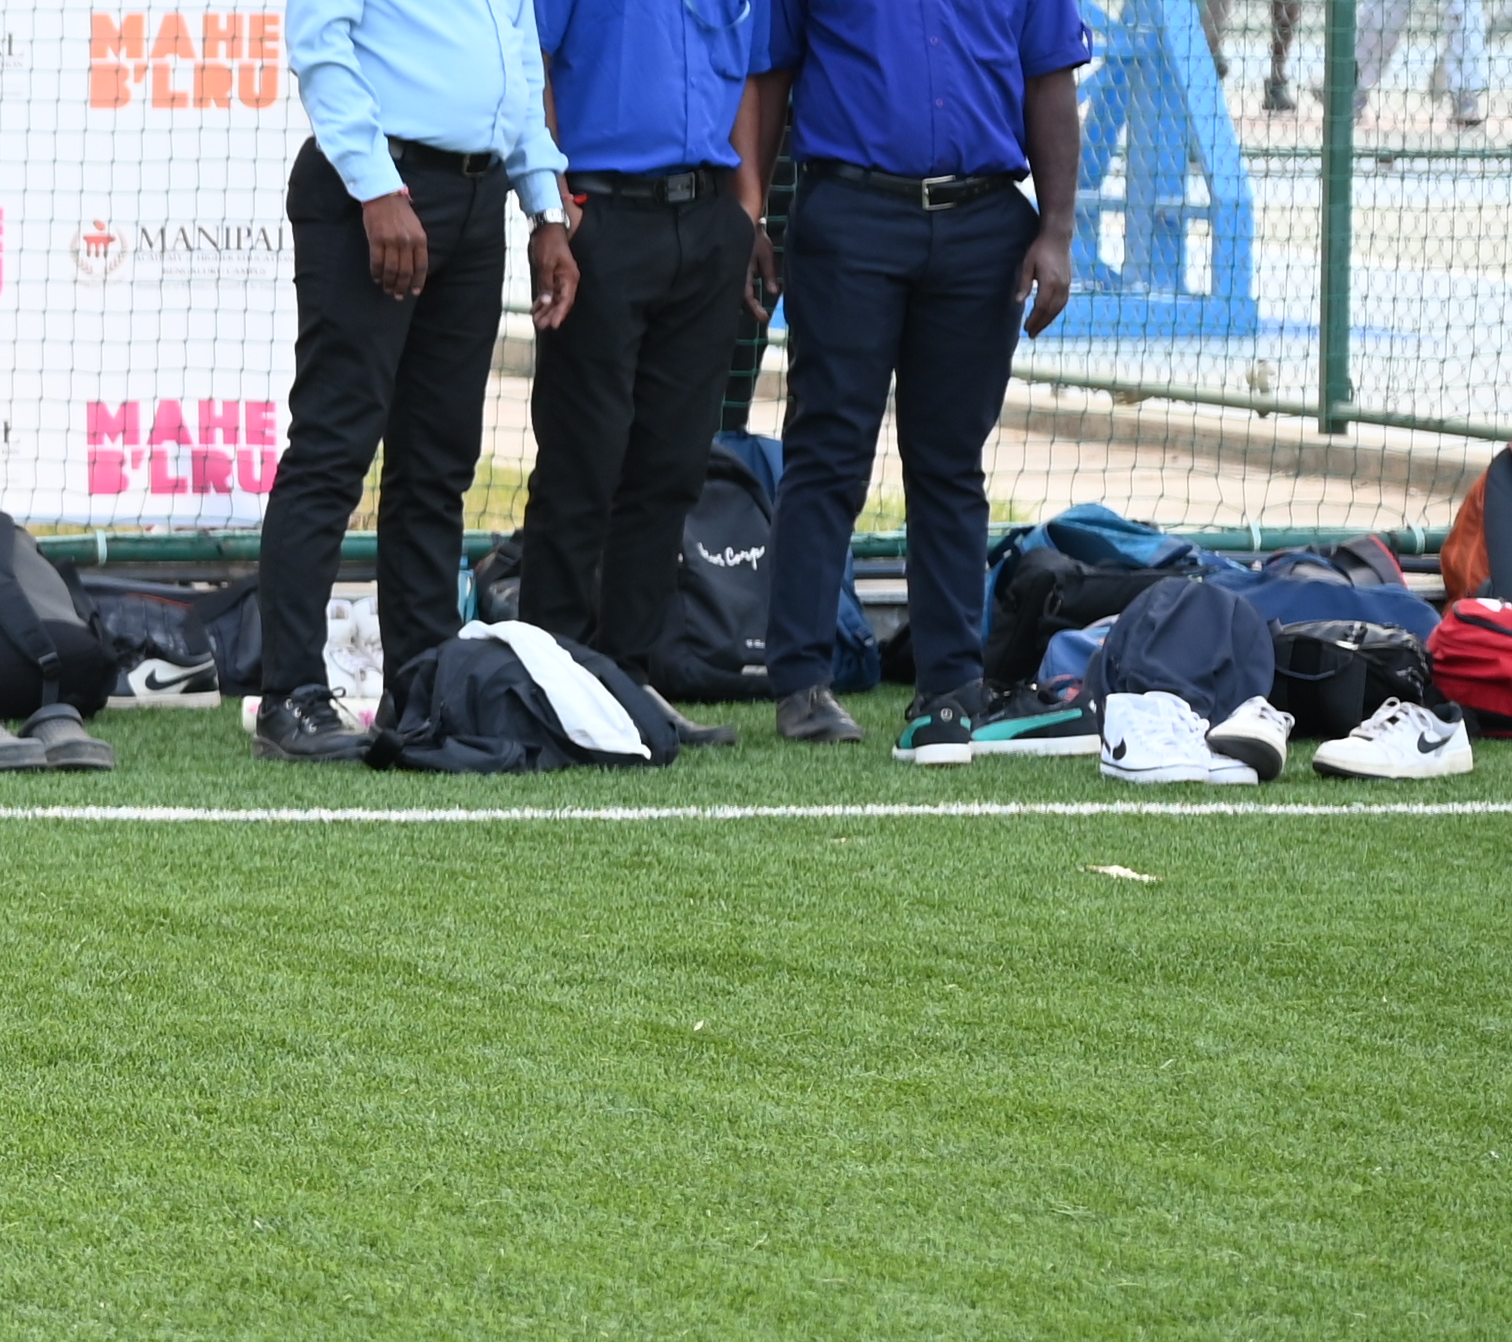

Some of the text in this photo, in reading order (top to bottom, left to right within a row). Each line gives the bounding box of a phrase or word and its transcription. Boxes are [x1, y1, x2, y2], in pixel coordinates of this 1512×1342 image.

[92, 16, 280, 60] MAHE
[92, 65, 279, 109] B'LRU
[139, 225, 294, 252] MANIPAL
[88, 401, 277, 447] MAHE
[89, 448, 279, 495] B'LRU
